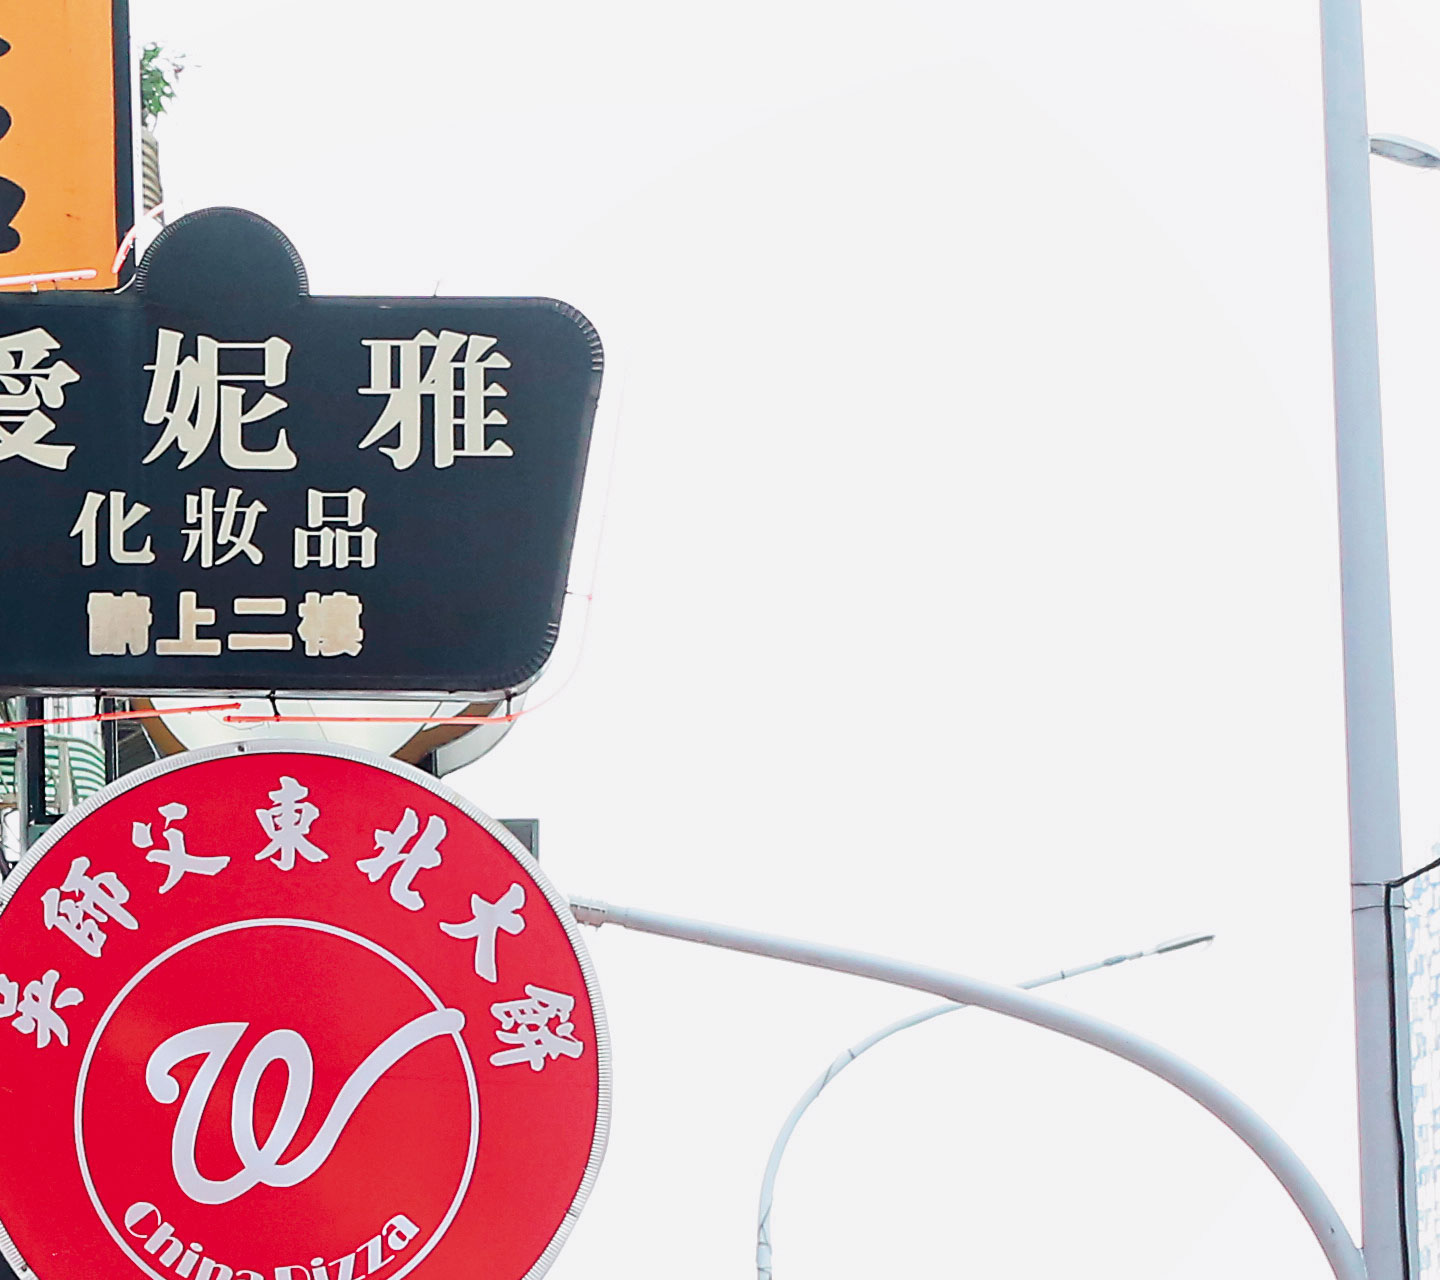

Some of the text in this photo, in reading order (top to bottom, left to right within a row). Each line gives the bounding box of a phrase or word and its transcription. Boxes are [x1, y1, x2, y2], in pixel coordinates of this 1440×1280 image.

[69, 488, 377, 569] 化妝品
[88, 590, 365, 656] 請上二樓
